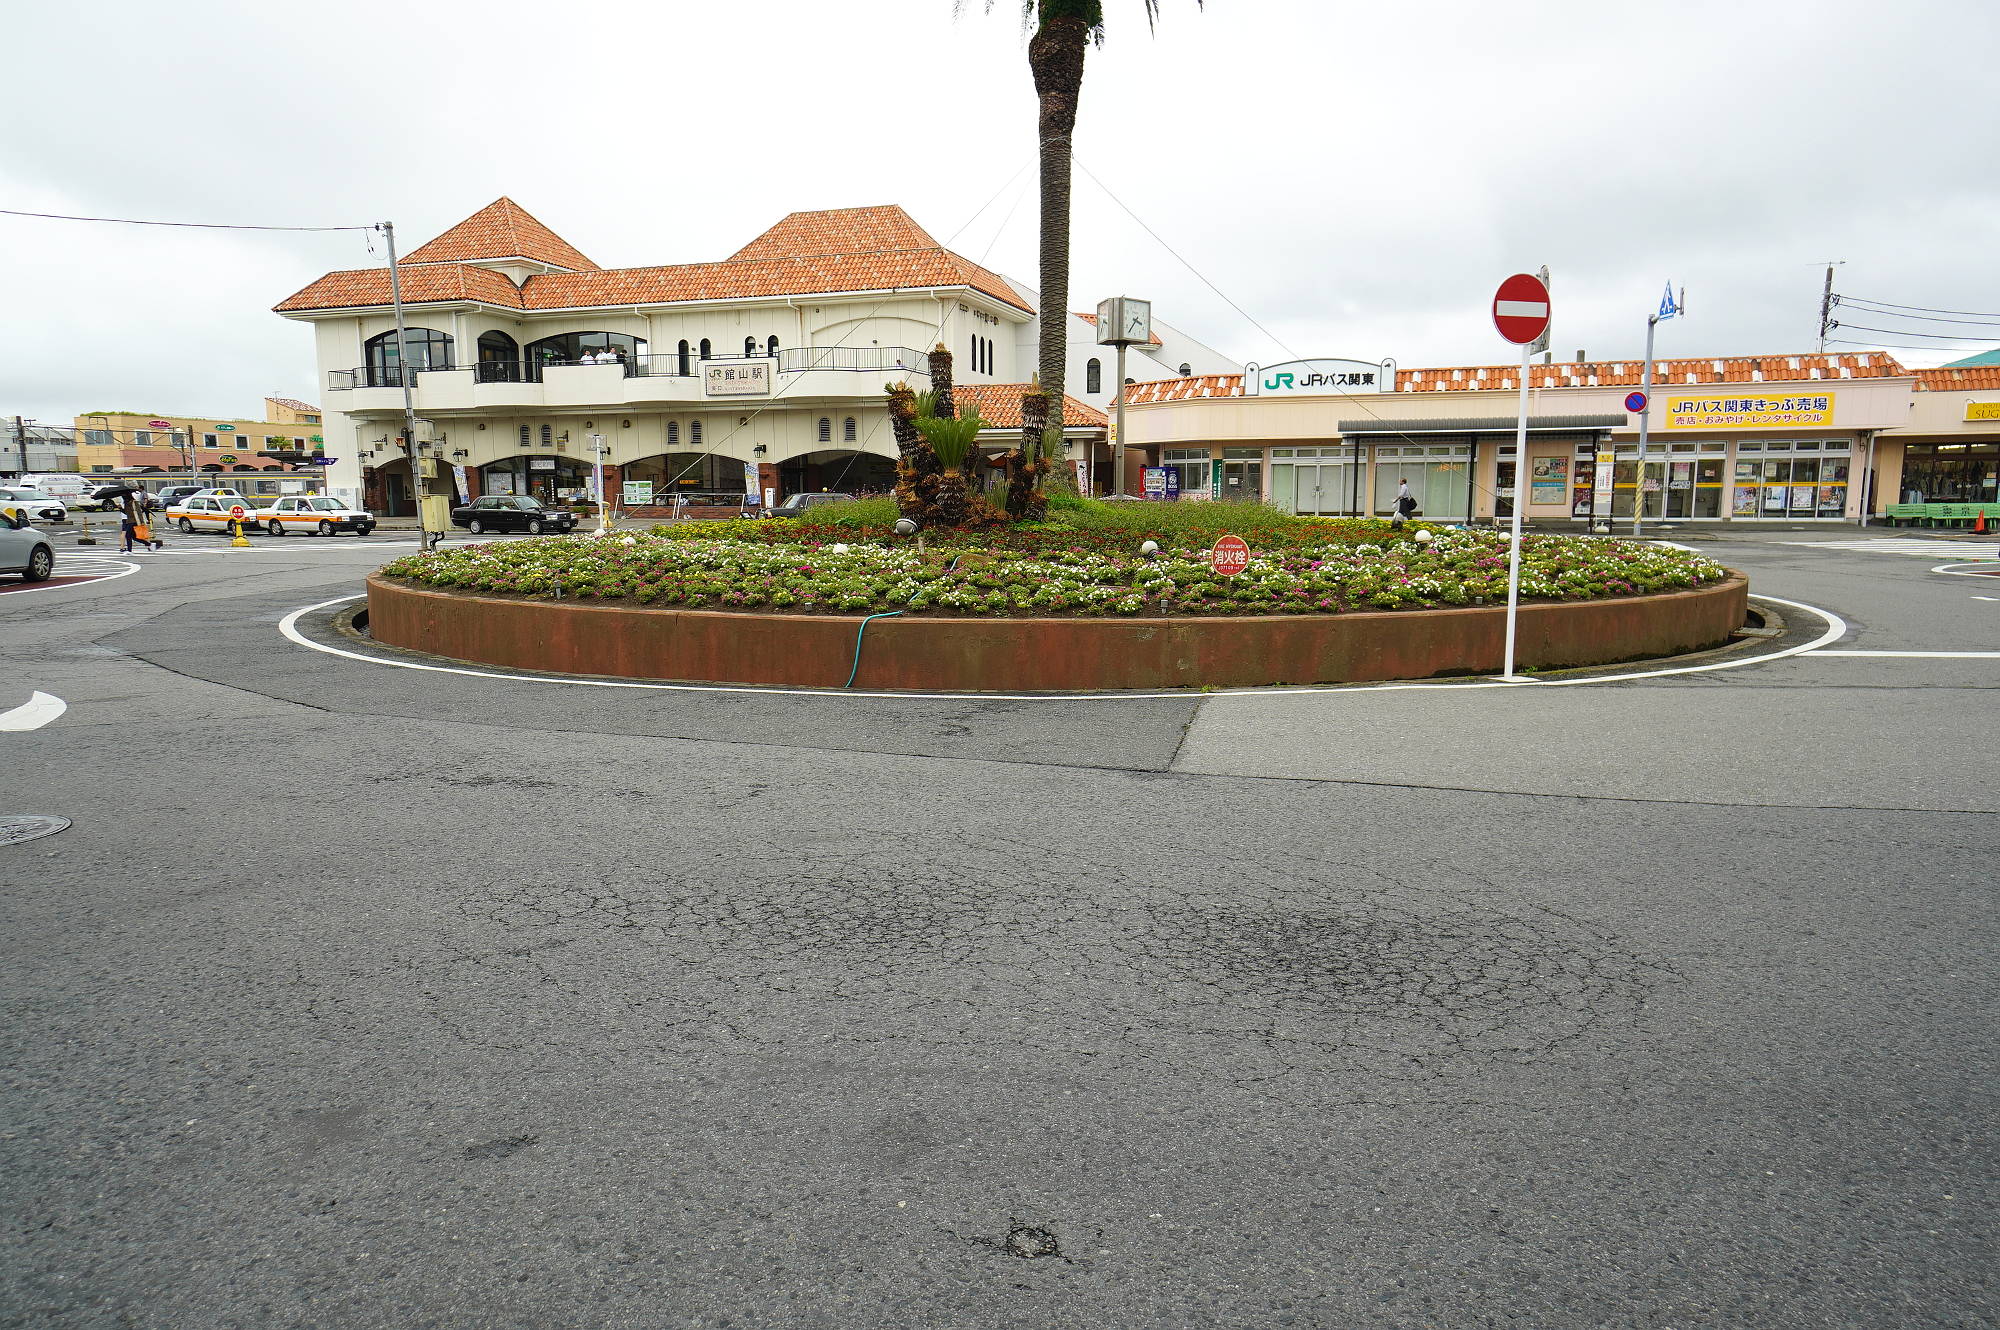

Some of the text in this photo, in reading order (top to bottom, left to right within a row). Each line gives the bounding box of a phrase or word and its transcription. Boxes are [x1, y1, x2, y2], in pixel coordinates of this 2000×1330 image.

[709, 367, 763, 380] JR 館山駅
[1300, 373, 1375, 386] JRバス関東
[1265, 373, 1294, 390] JR
[1672, 397, 1828, 413] JRバス関東きっぷ売場
[1675, 413, 1823, 425] 売店・おみやげ・レンタサイクル
[1215, 550, 1246, 565] 消火栓
